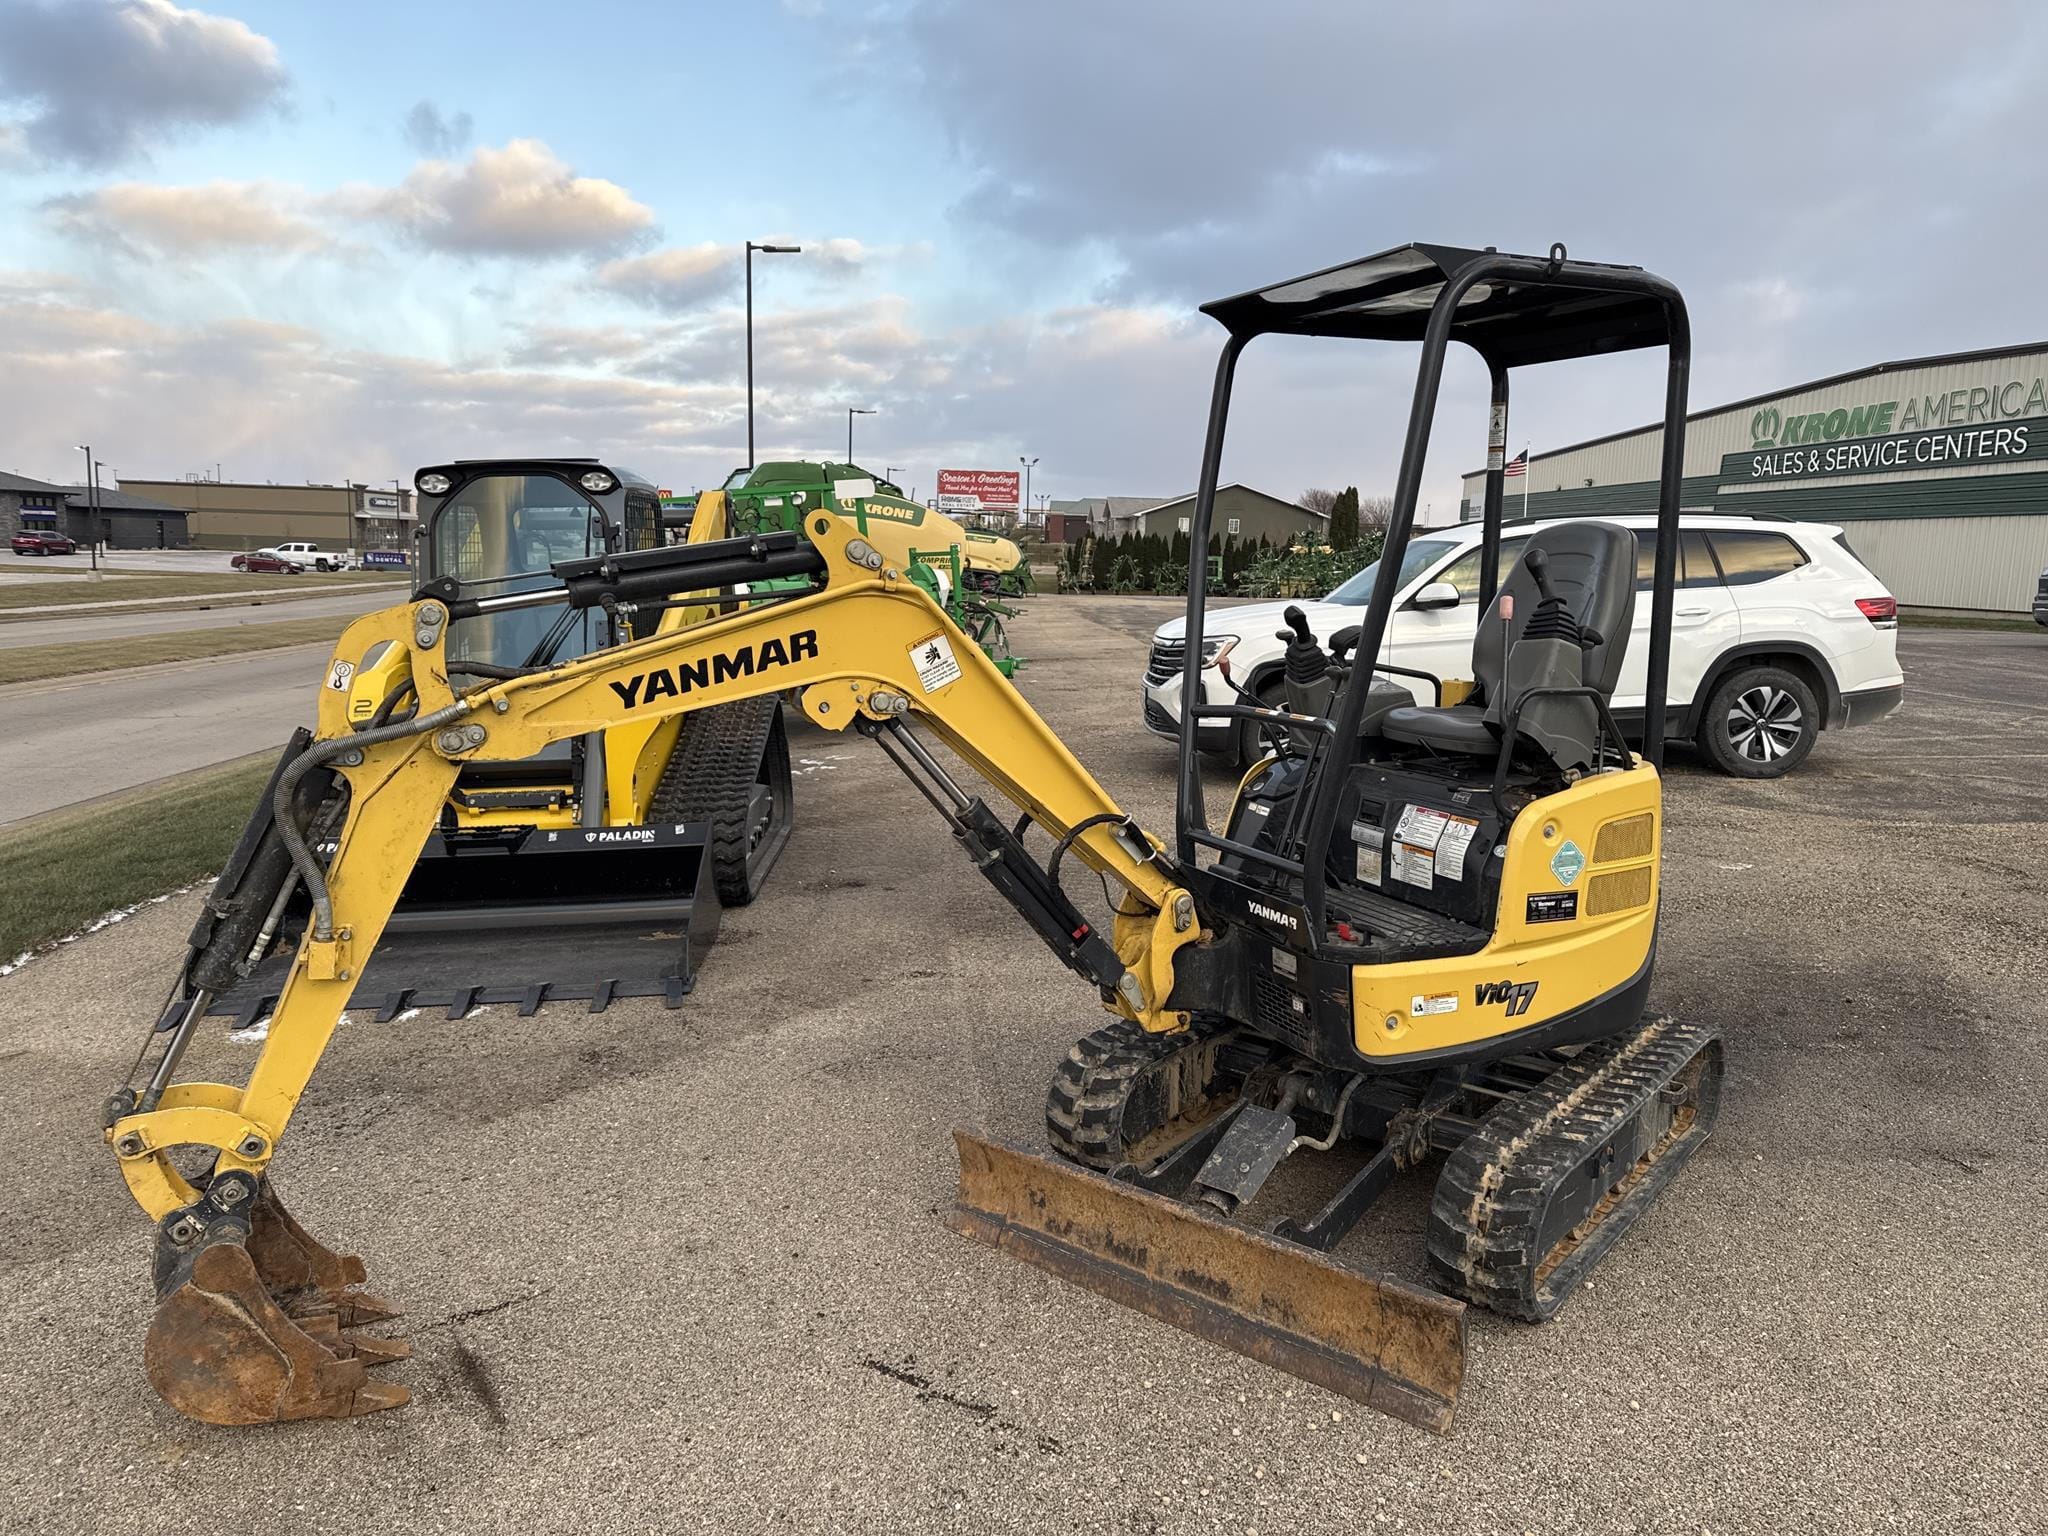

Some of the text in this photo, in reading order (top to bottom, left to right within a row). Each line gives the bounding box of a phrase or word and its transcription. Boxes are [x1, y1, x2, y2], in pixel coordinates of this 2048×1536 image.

[1779, 377, 2048, 445] KRONE AMERICA
[1751, 426, 2029, 477] SALES & SERVICE CENTERS
[941, 473, 1017, 486] Season's Greetings
[864, 503, 914, 520] KRONE
[917, 631, 939, 645] WARNING
[608, 629, 819, 710] YANMAR
[354, 700, 373, 713] 2
[598, 830, 655, 841] PALADIN
[1247, 900, 1297, 931] YANMAR
